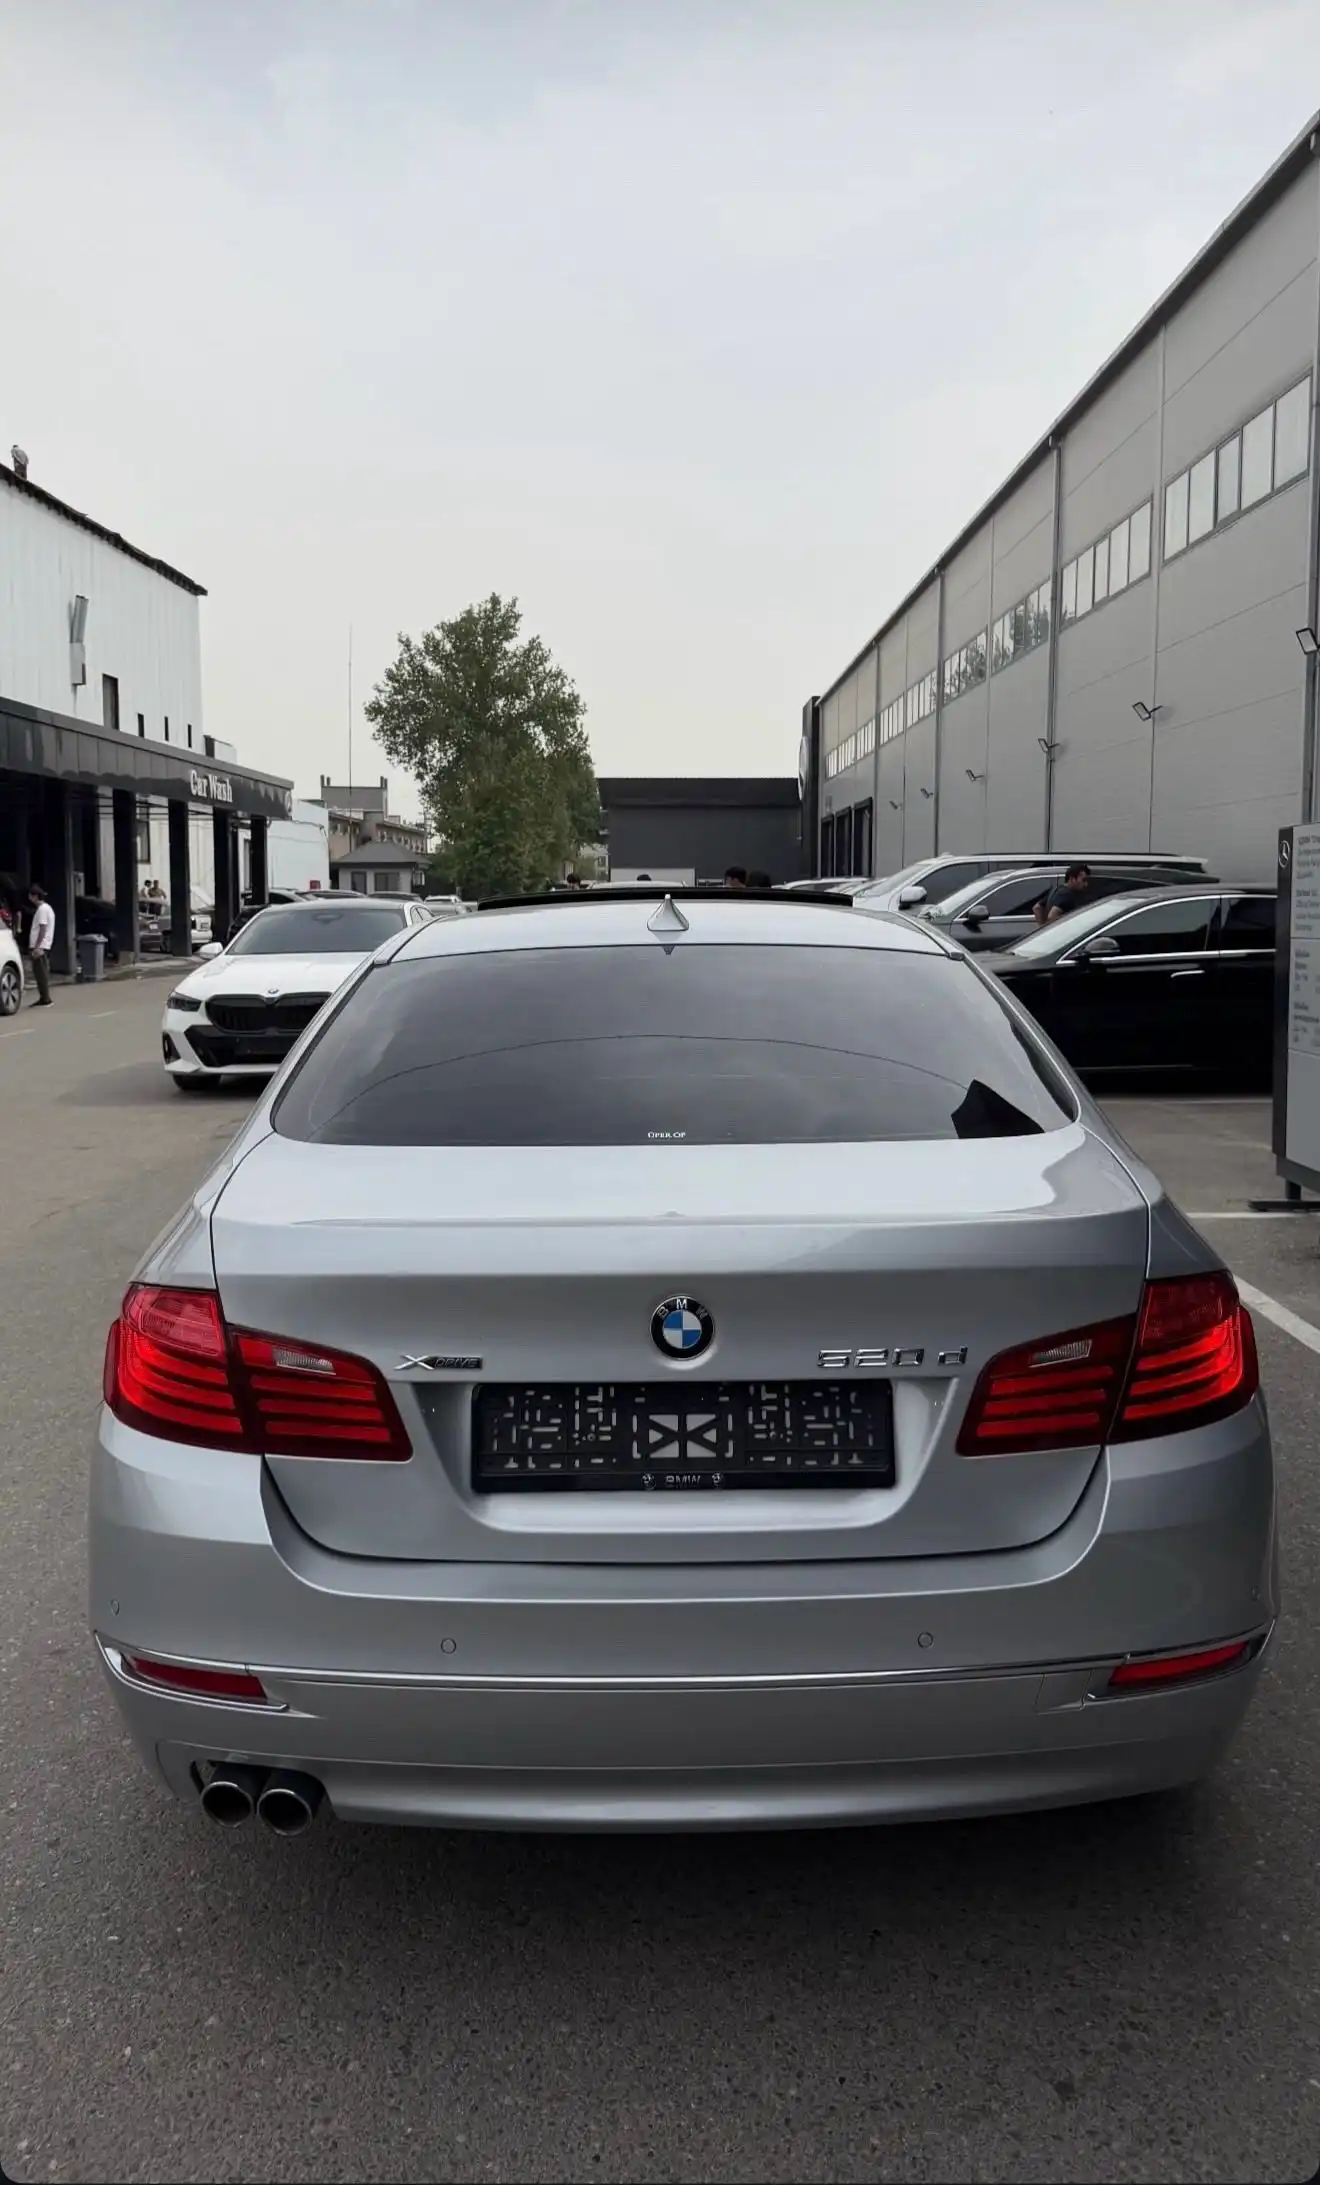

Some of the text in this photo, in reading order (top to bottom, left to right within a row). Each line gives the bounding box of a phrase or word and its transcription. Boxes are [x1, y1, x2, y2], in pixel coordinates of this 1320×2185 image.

[190, 770, 233, 803] Car Wash
[656, 1298, 708, 1320] BMW
[665, 1475, 701, 1488] BMW
